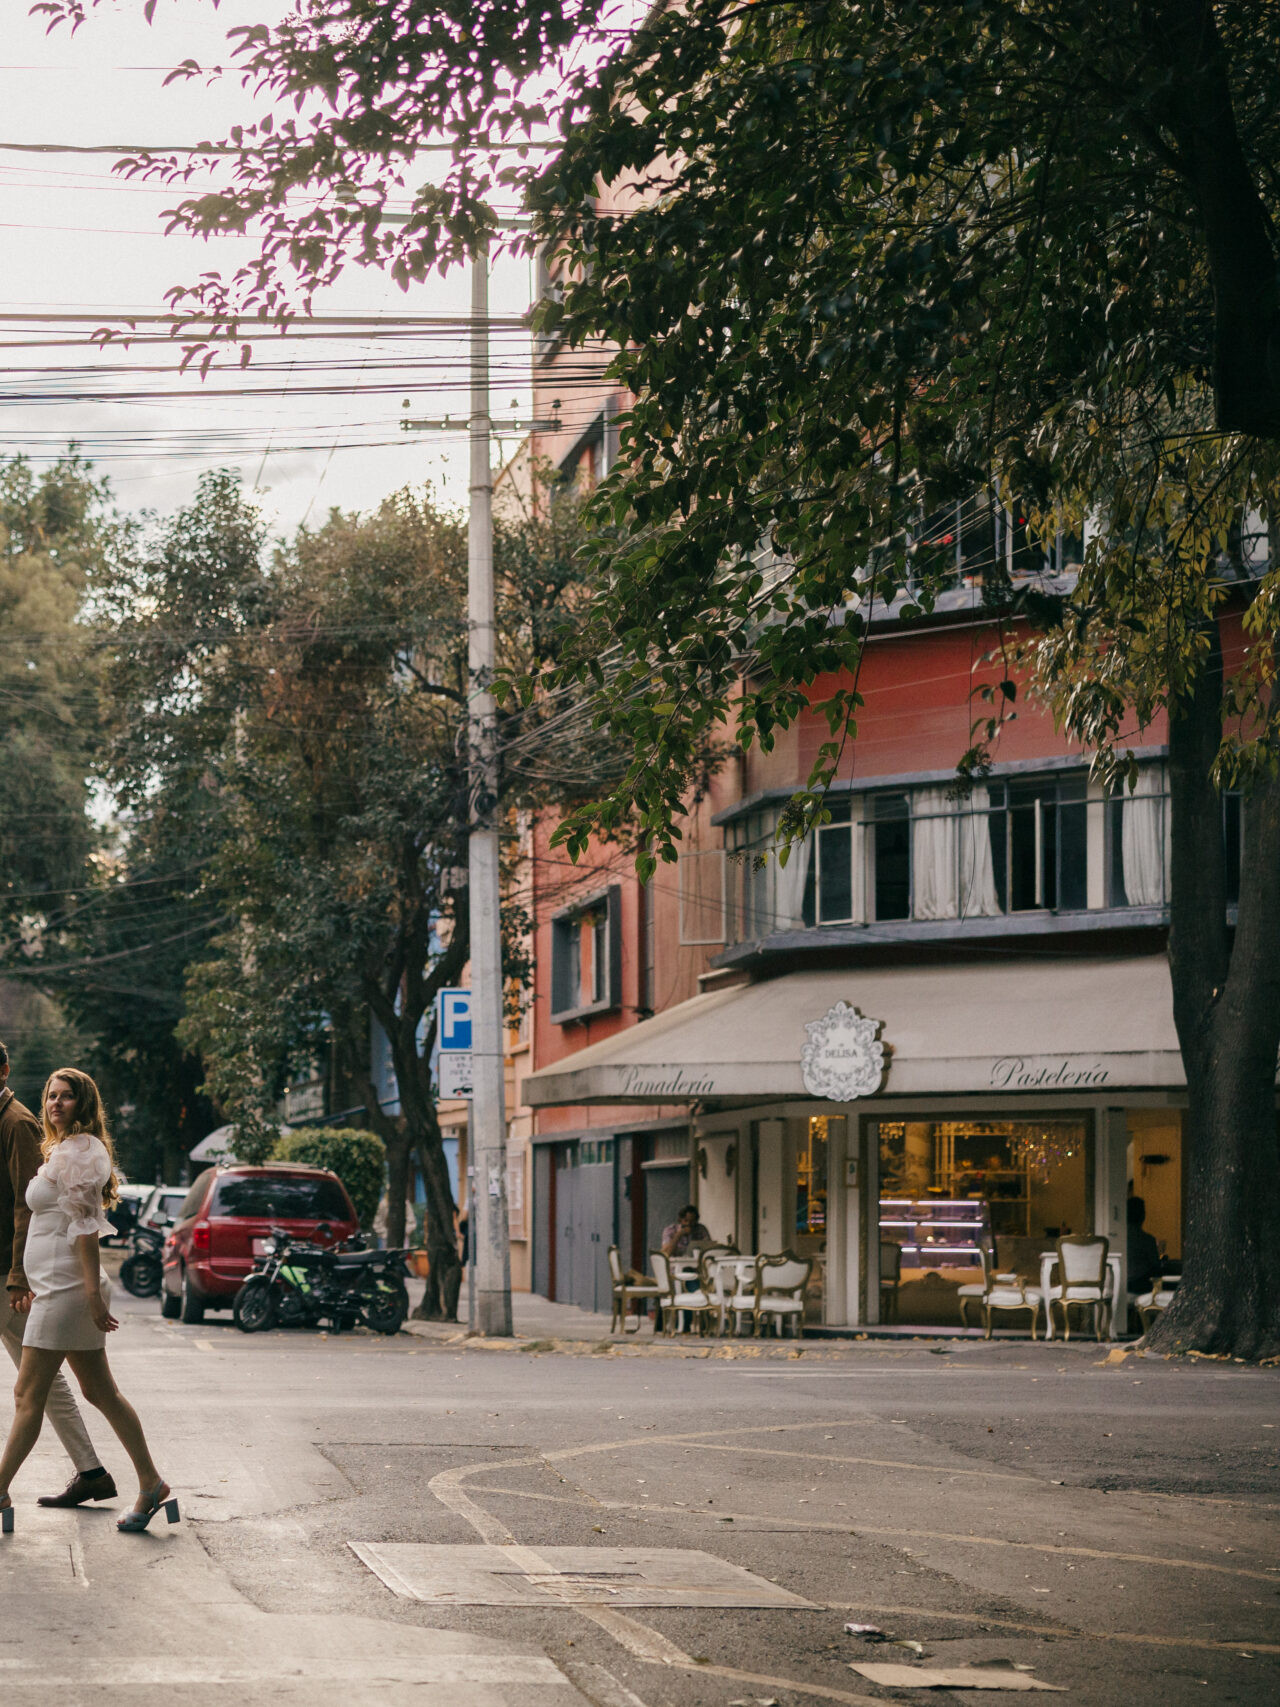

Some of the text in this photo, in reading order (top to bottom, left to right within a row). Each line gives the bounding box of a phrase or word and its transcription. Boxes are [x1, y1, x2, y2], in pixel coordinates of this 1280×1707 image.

[825, 1049, 858, 1058] DELISA
[618, 1064, 716, 1095] Panadería
[989, 1055, 1110, 1087] Pastelería
